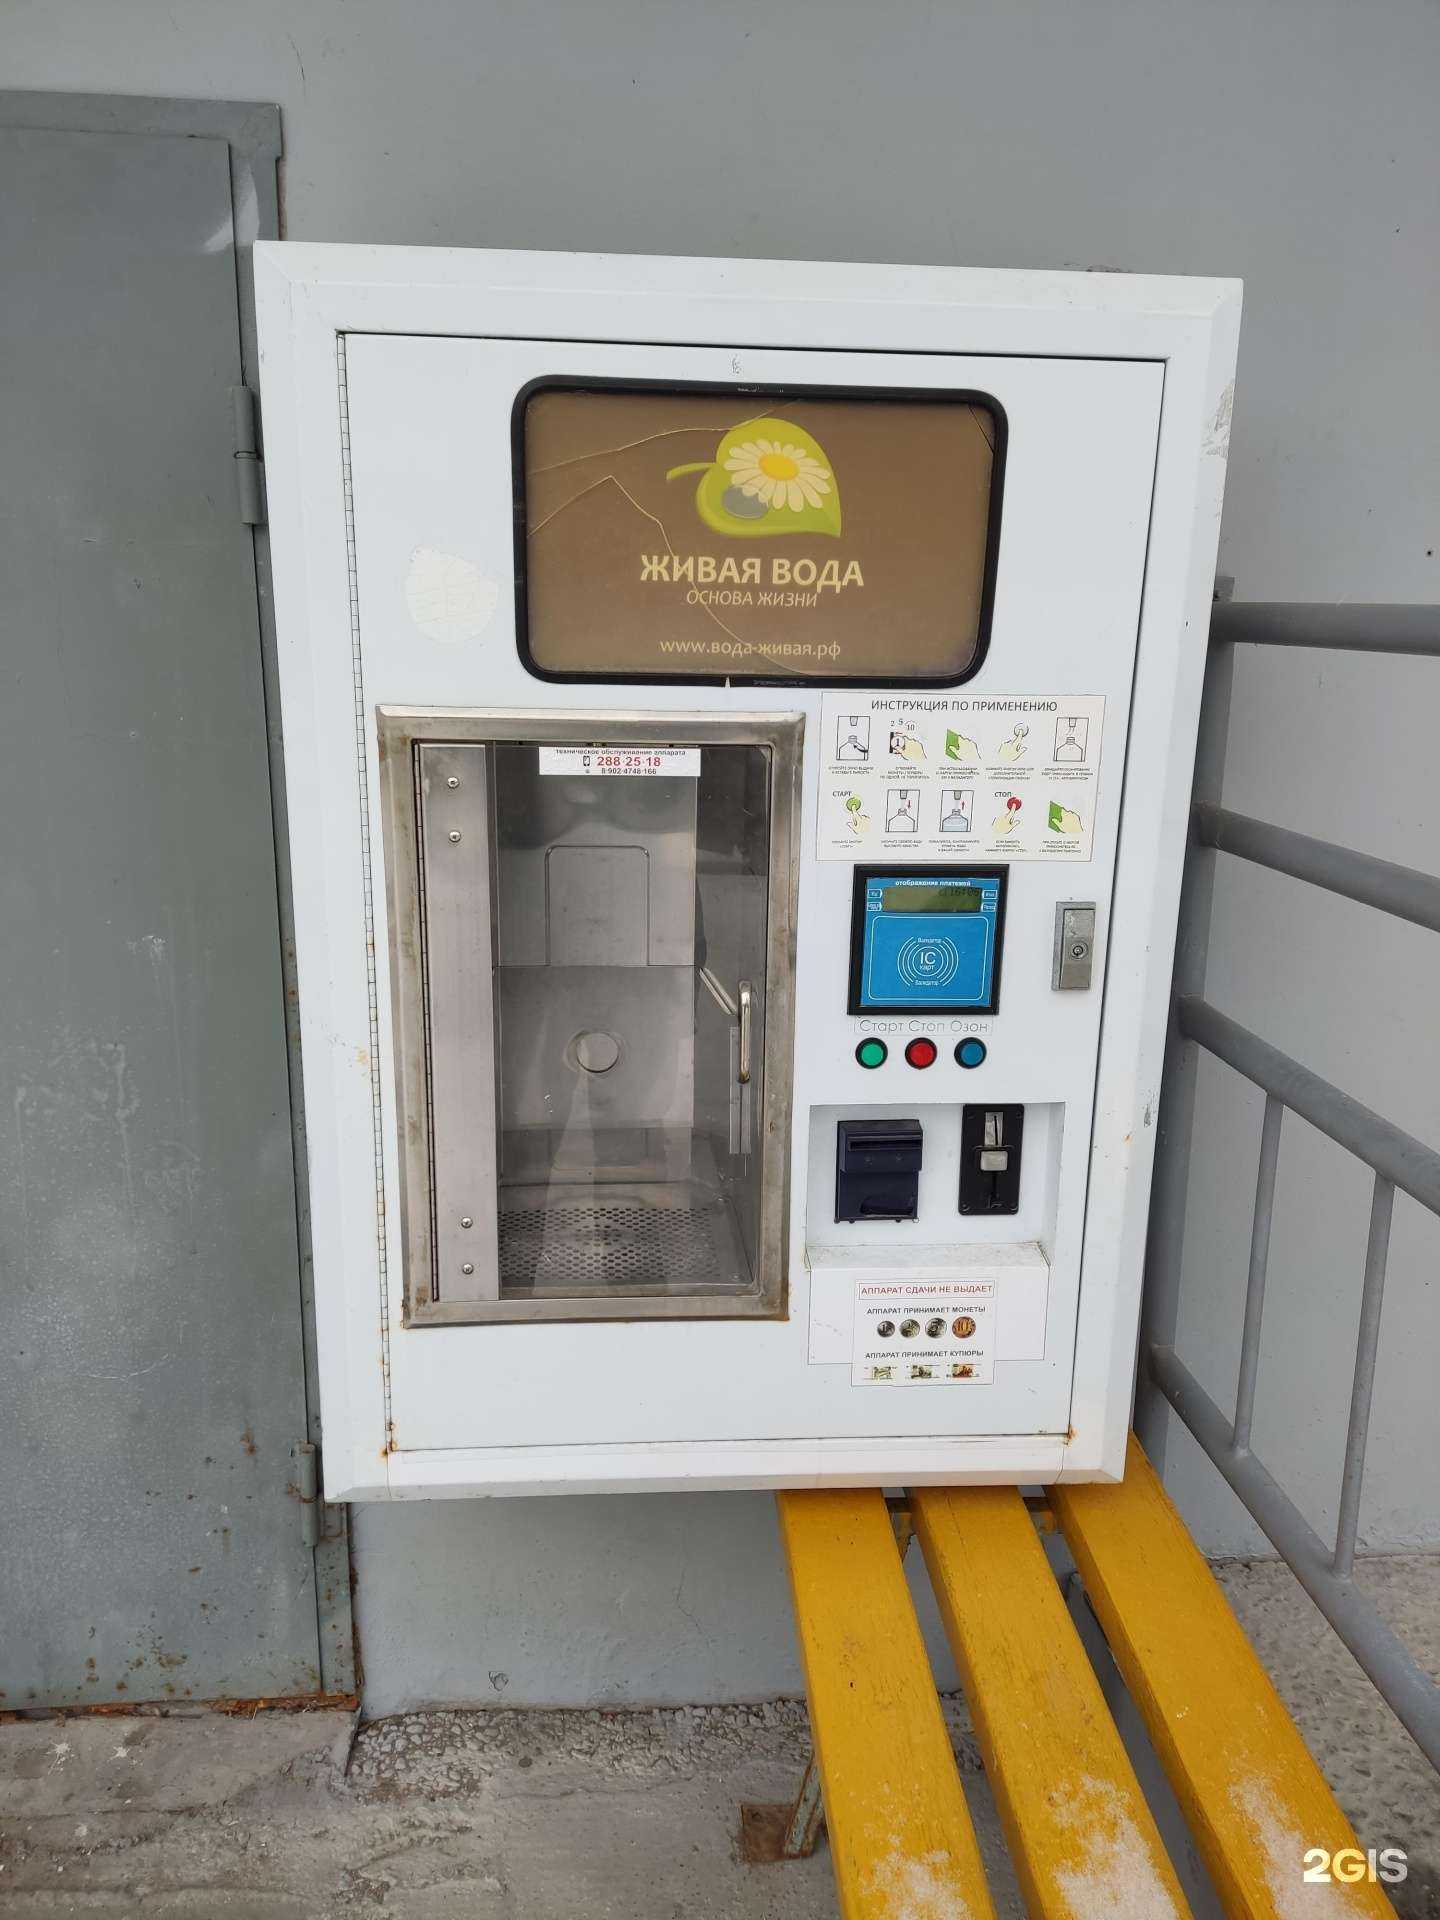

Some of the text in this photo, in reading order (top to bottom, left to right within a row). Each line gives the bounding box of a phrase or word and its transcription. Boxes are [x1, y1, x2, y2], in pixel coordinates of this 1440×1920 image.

[640, 554, 865, 593] ЖИВАЯ ВОДА
[686, 590, 818, 608] ОСНОВА ЖИЗНИ
[660, 640, 841, 660] www.вода-живая.рф
[871, 700, 1058, 712] ИНСТРУКЦИЯ ПО ПРИМЕНЕНИЮ
[920, 951, 936, 965] IC
[859, 1019, 988, 1034] Старт Стоп Озон
[861, 1286, 902, 1295] АППАРАТ
[905, 1286, 936, 1294] СДАЧИ
[953, 1285, 992, 1293] ВЫДАЕТ
[866, 1307, 900, 1315] АППАРАТ
